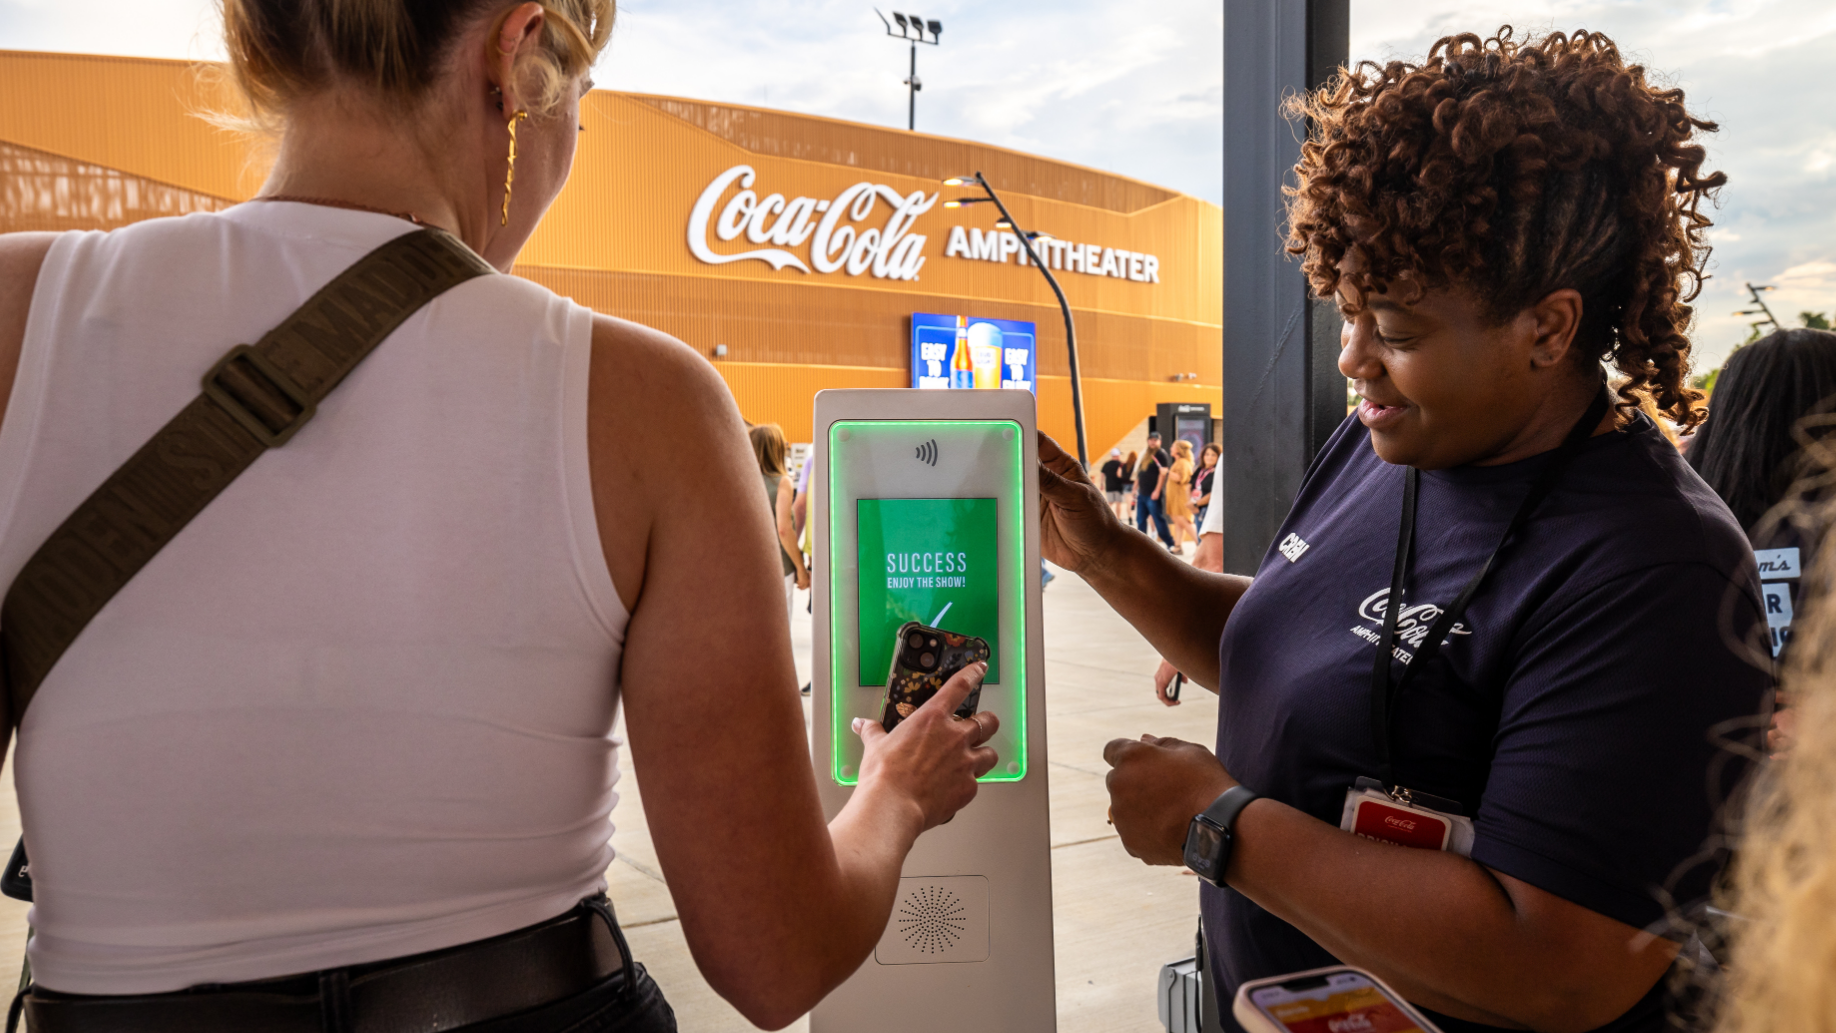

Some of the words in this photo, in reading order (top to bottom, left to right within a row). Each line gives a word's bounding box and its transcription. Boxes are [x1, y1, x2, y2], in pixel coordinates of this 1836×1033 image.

[687, 164, 941, 281] Coca-Cola
[945, 225, 1160, 284] AMPHITHEATER
[921, 343, 946, 361] EASY
[1005, 348, 1028, 365] EASY
[927, 360, 941, 376] TO
[1010, 364, 1023, 380] TO
[1278, 532, 1311, 564] CREW
[887, 552, 967, 573] SUCCESS
[887, 576, 914, 589] ENJOY
[917, 576, 933, 588] THE
[935, 576, 966, 588] SHOW!
